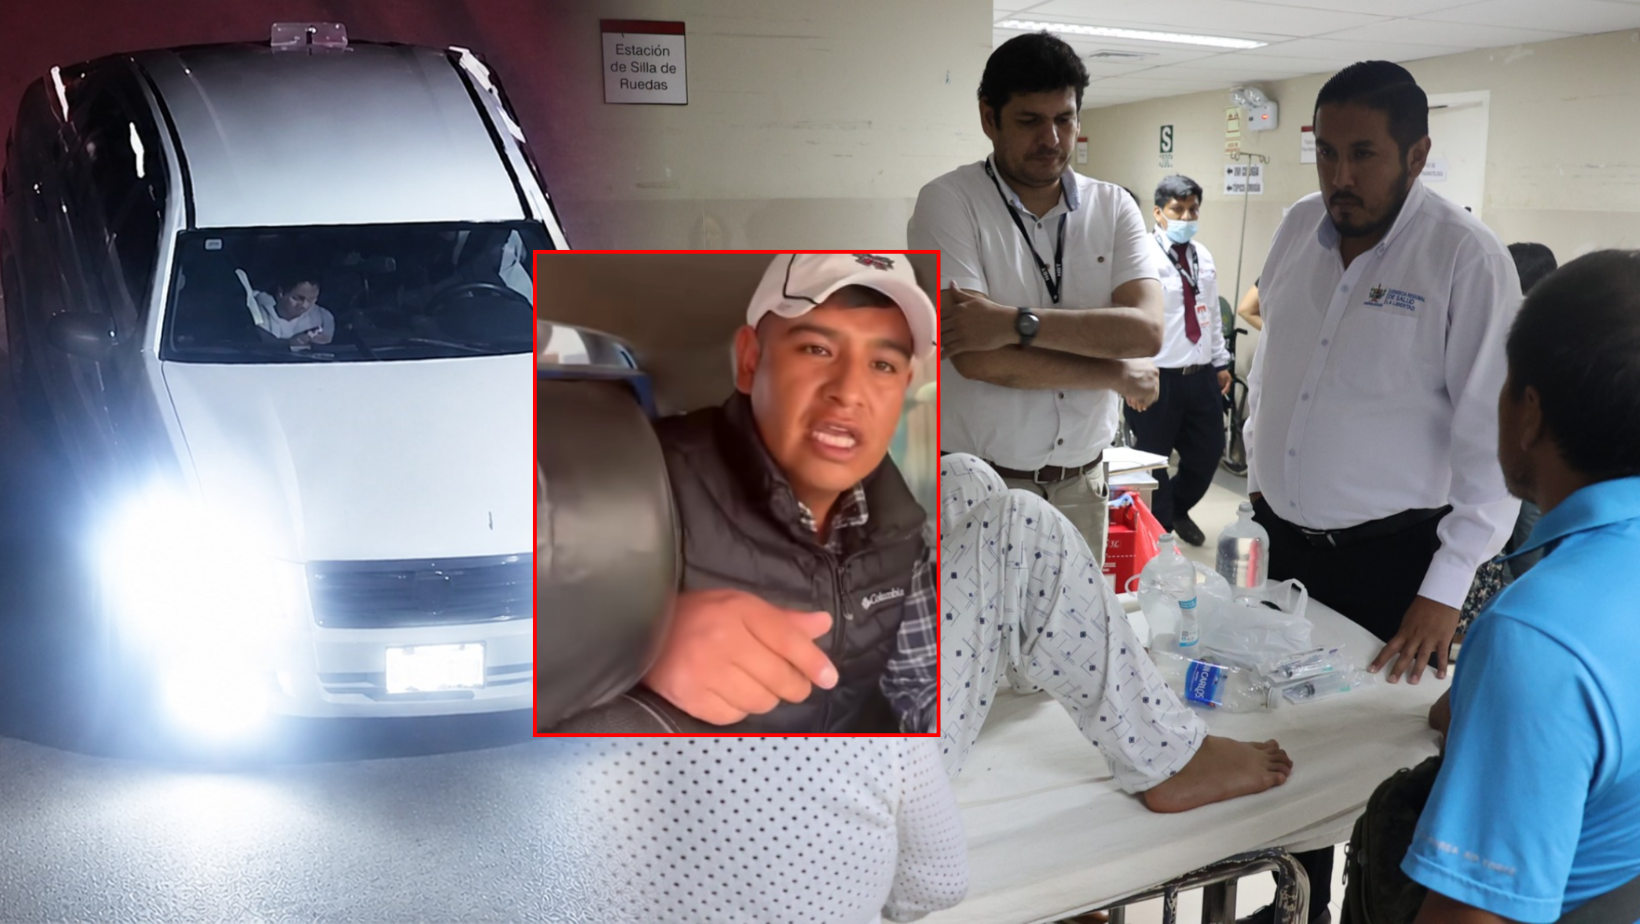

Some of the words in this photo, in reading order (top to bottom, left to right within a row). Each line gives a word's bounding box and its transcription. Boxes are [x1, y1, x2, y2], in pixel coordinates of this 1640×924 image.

[616, 43, 670, 56] Estación
[610, 61, 626, 72] de
[630, 61, 657, 73] Silla
[660, 62, 676, 74] de
[620, 78, 668, 90] Ruedas
[1162, 126, 1171, 152] S
[1392, 301, 1415, 311] LIBERTAD
[1396, 295, 1415, 305] SALUD
[869, 587, 905, 604] Columbia
[1194, 672, 1209, 698] CARLOS
